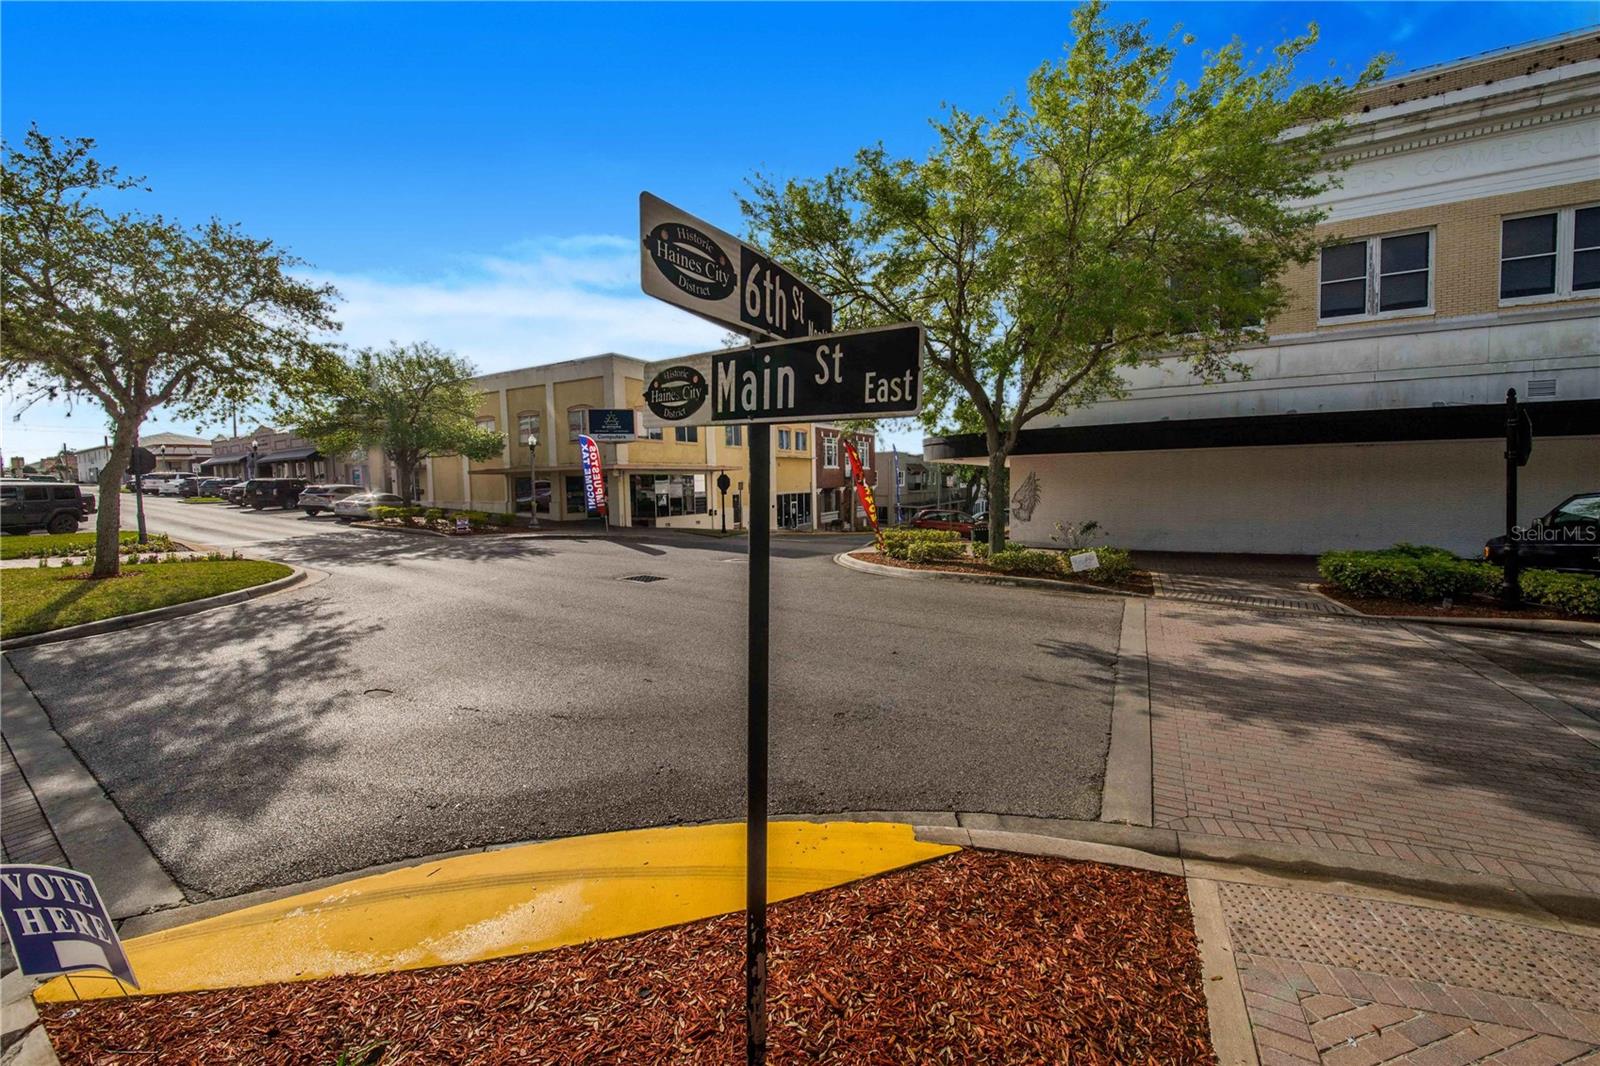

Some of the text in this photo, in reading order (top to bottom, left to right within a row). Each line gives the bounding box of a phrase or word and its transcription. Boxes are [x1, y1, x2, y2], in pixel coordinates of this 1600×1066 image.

[677, 227, 714, 254] Historic
[656, 240, 730, 287] Haines City
[678, 274, 711, 296] District
[745, 263, 805, 331] 6th St
[663, 369, 689, 379] Historic
[717, 343, 913, 413] Main St East
[651, 385, 702, 403] Haines City
[663, 408, 687, 418] District
[0, 873, 94, 908] VOTE
[13, 906, 112, 945] HERE
